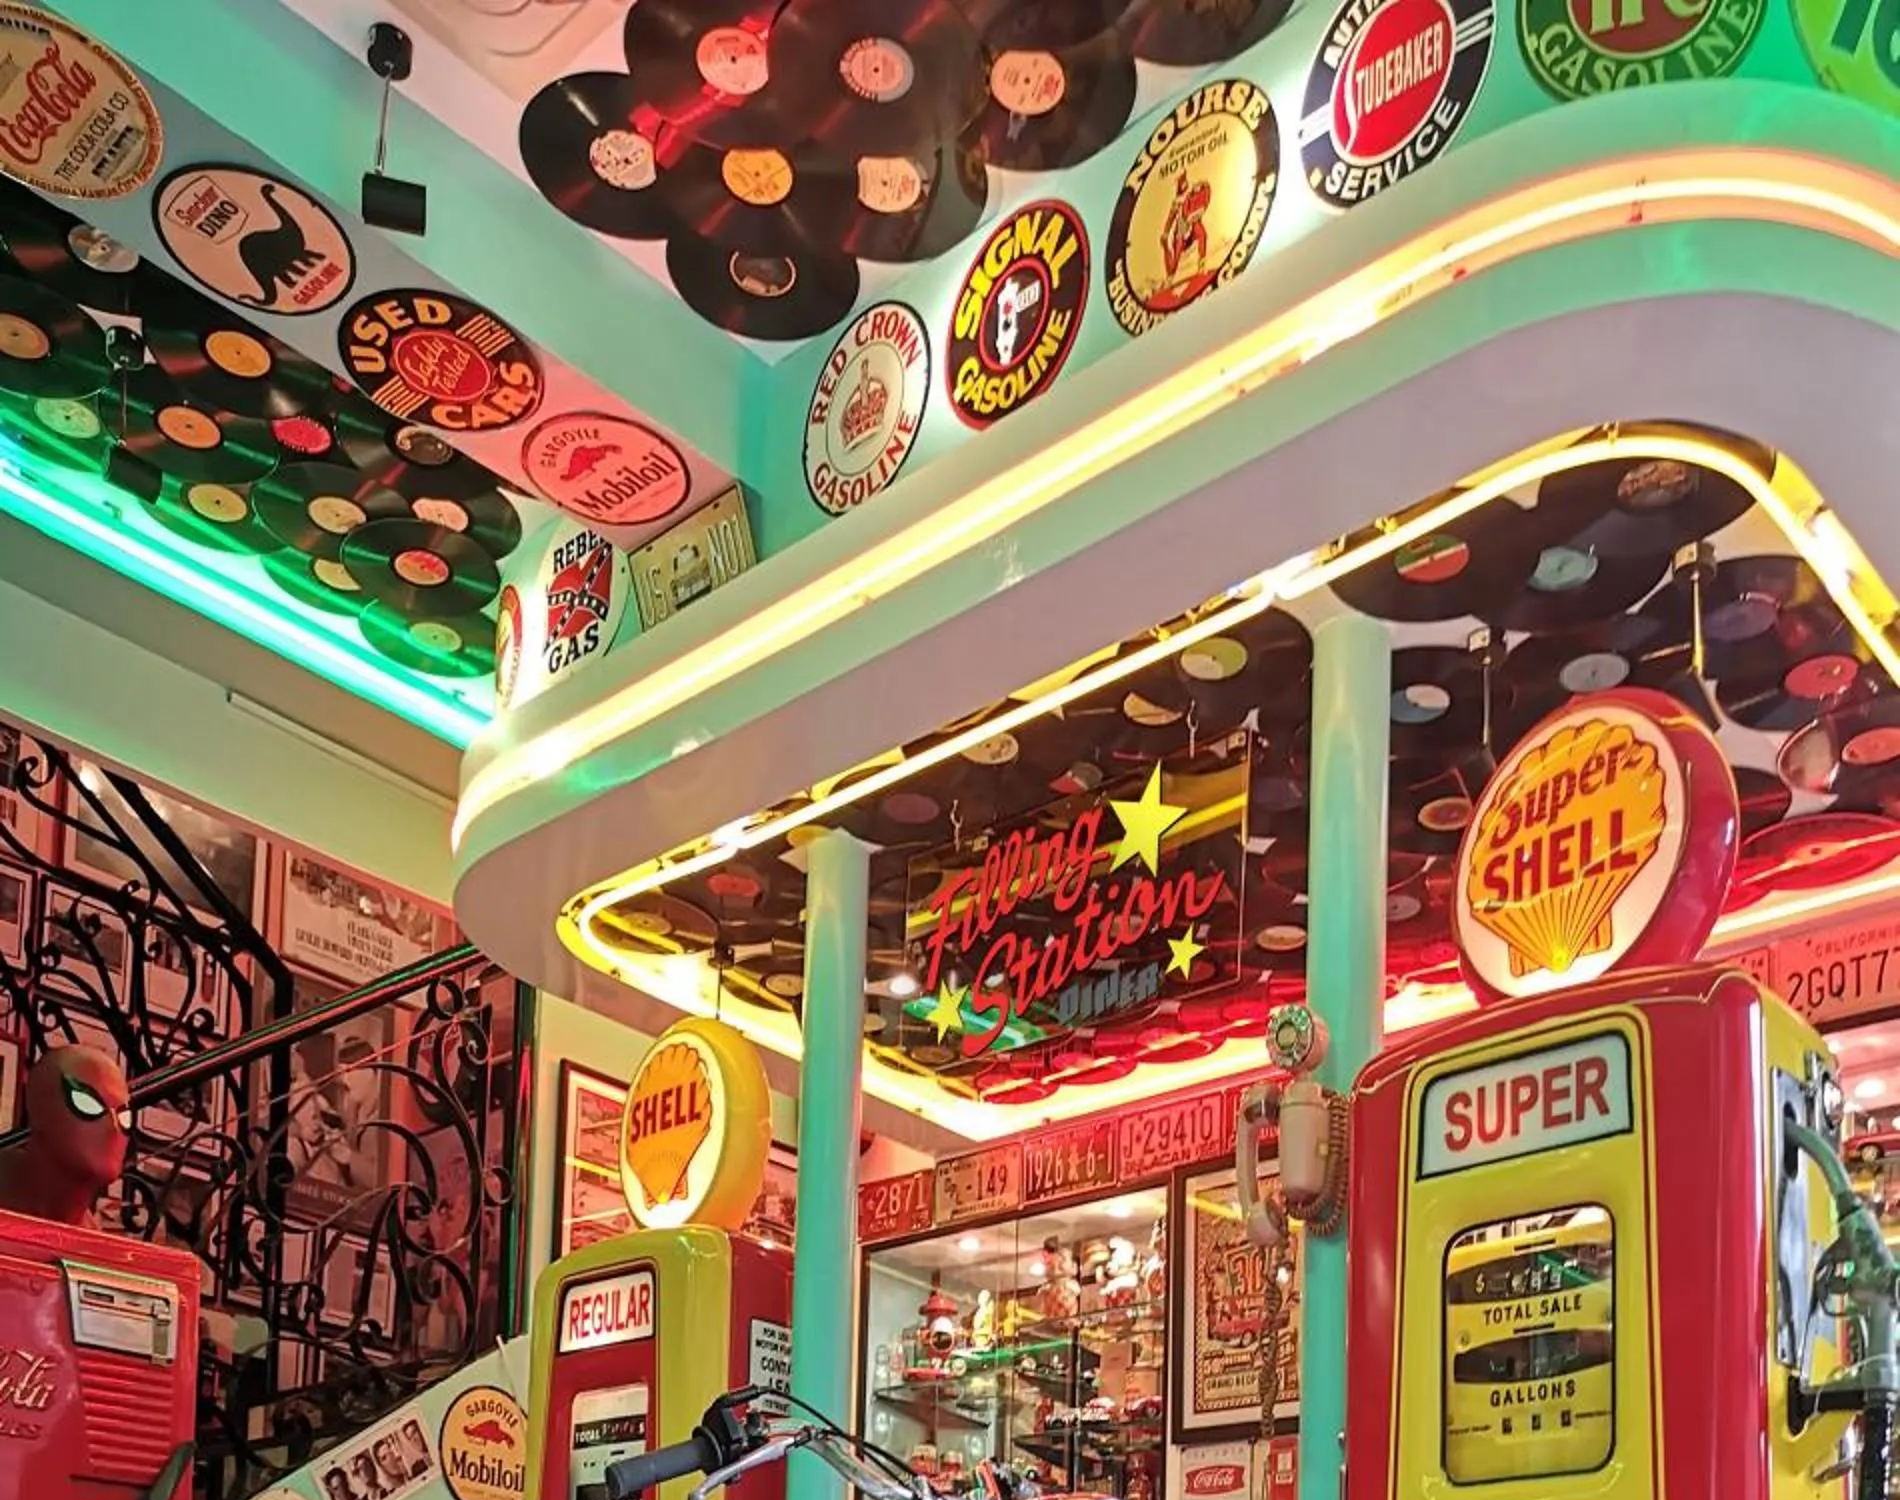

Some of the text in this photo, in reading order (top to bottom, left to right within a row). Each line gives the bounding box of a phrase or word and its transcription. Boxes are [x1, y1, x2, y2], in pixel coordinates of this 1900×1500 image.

[1126, 80, 1268, 194] NOURSE
[1325, 98, 1460, 200] SERVICE
[197, 200, 239, 239] DINO
[954, 210, 1078, 340] SIGNAL
[350, 298, 452, 373] USED
[810, 310, 922, 426] RED CROWN
[953, 309, 1072, 415] GASOLINE
[431, 361, 535, 429] CARS
[573, 449, 679, 517] Mobiloil
[813, 409, 918, 509] GASOLINE
[548, 622, 599, 675] GAS
[1490, 738, 1645, 851] Super
[1482, 809, 1638, 904] SHELL
[926, 806, 1109, 993] Filling
[961, 869, 1226, 1058] Station
[1815, 925, 1900, 959] CALIFORNI
[1057, 962, 1161, 1026] DINER
[1787, 946, 1900, 1011] 2GQT7
[630, 1080, 701, 1144] SHELL
[1444, 1055, 1612, 1152] SUPER
[568, 1283, 650, 1341] REGULAR
[1484, 1294, 1582, 1326] TOTAL SALE
[466, 1399, 519, 1428] GARGOYLE
[769, 1377, 790, 1396] LEA
[1490, 1379, 1576, 1408] GALLONS
[449, 1447, 526, 1493] Mobiloil
